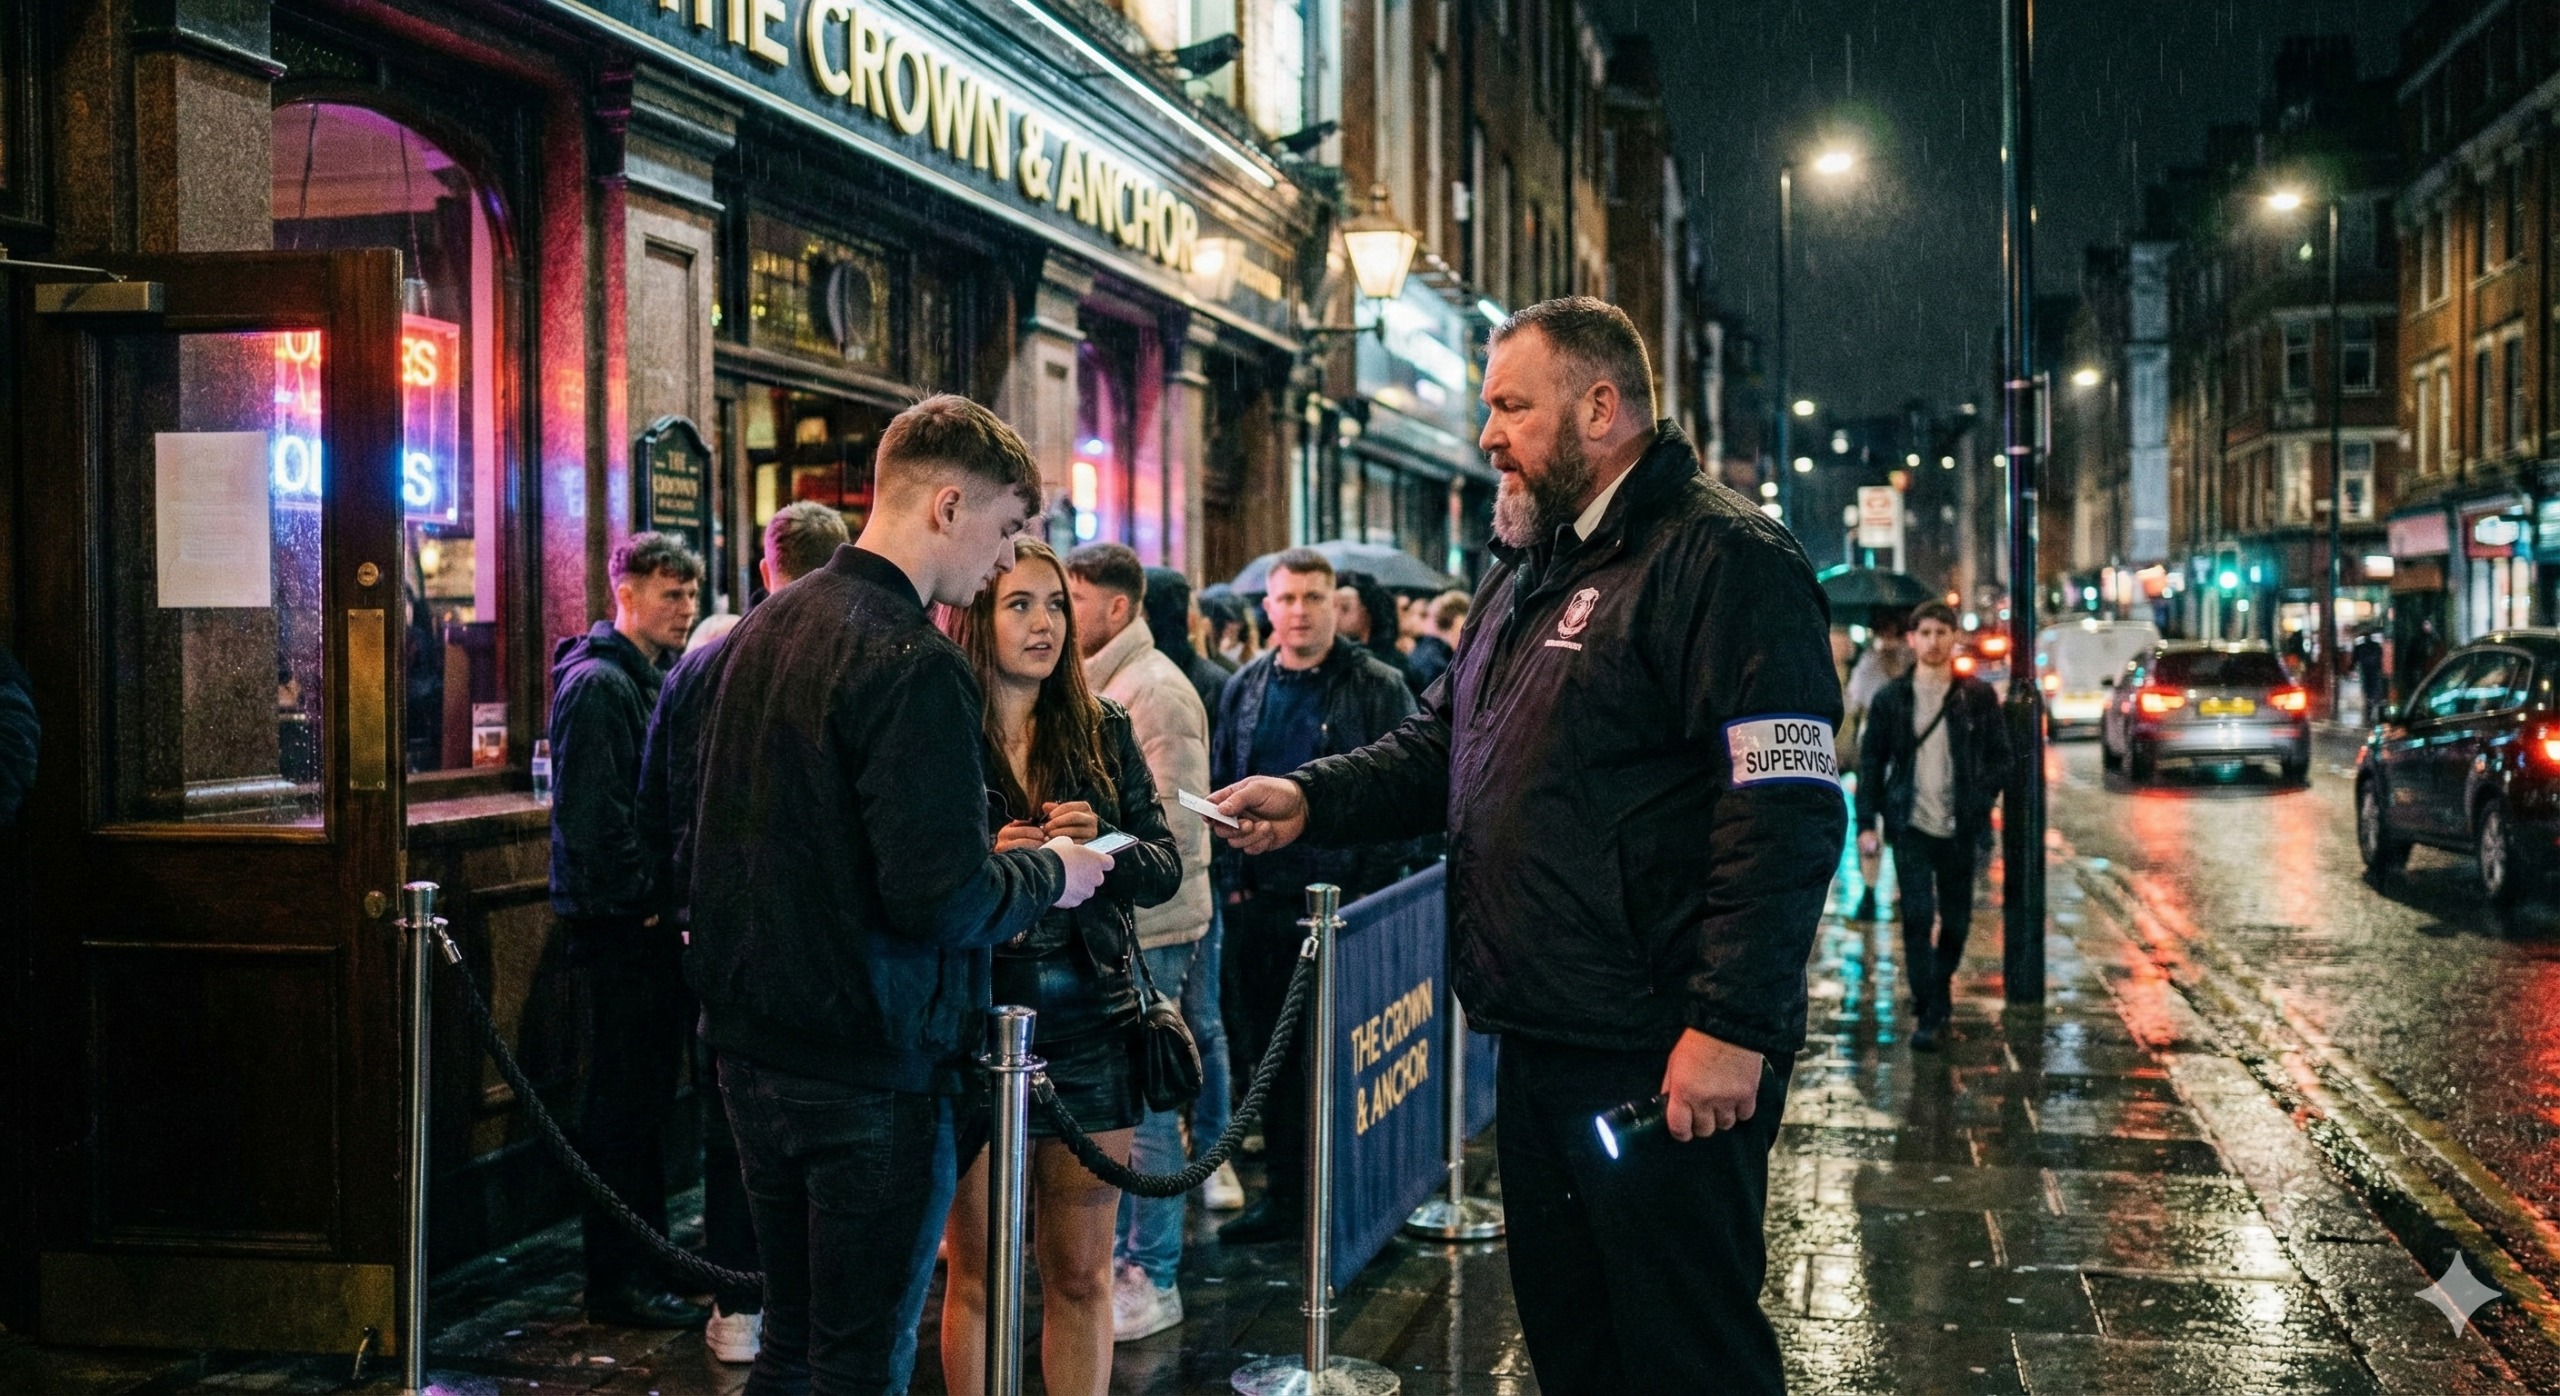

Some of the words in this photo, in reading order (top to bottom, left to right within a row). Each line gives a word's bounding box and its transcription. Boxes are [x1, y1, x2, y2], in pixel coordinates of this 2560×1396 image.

[806, 0, 1010, 181] CROWN
[1018, 111, 1052, 201] &
[1056, 138, 1198, 272] ANCHOR
[1746, 749, 1836, 776] SUPERVISO
[1774, 723, 1822, 748] DOOR
[1351, 1014, 1381, 1076] THE
[1382, 976, 1433, 1053] CROWN
[1356, 1087, 1369, 1136] &
[1370, 1037, 1429, 1126] ANCHOR
